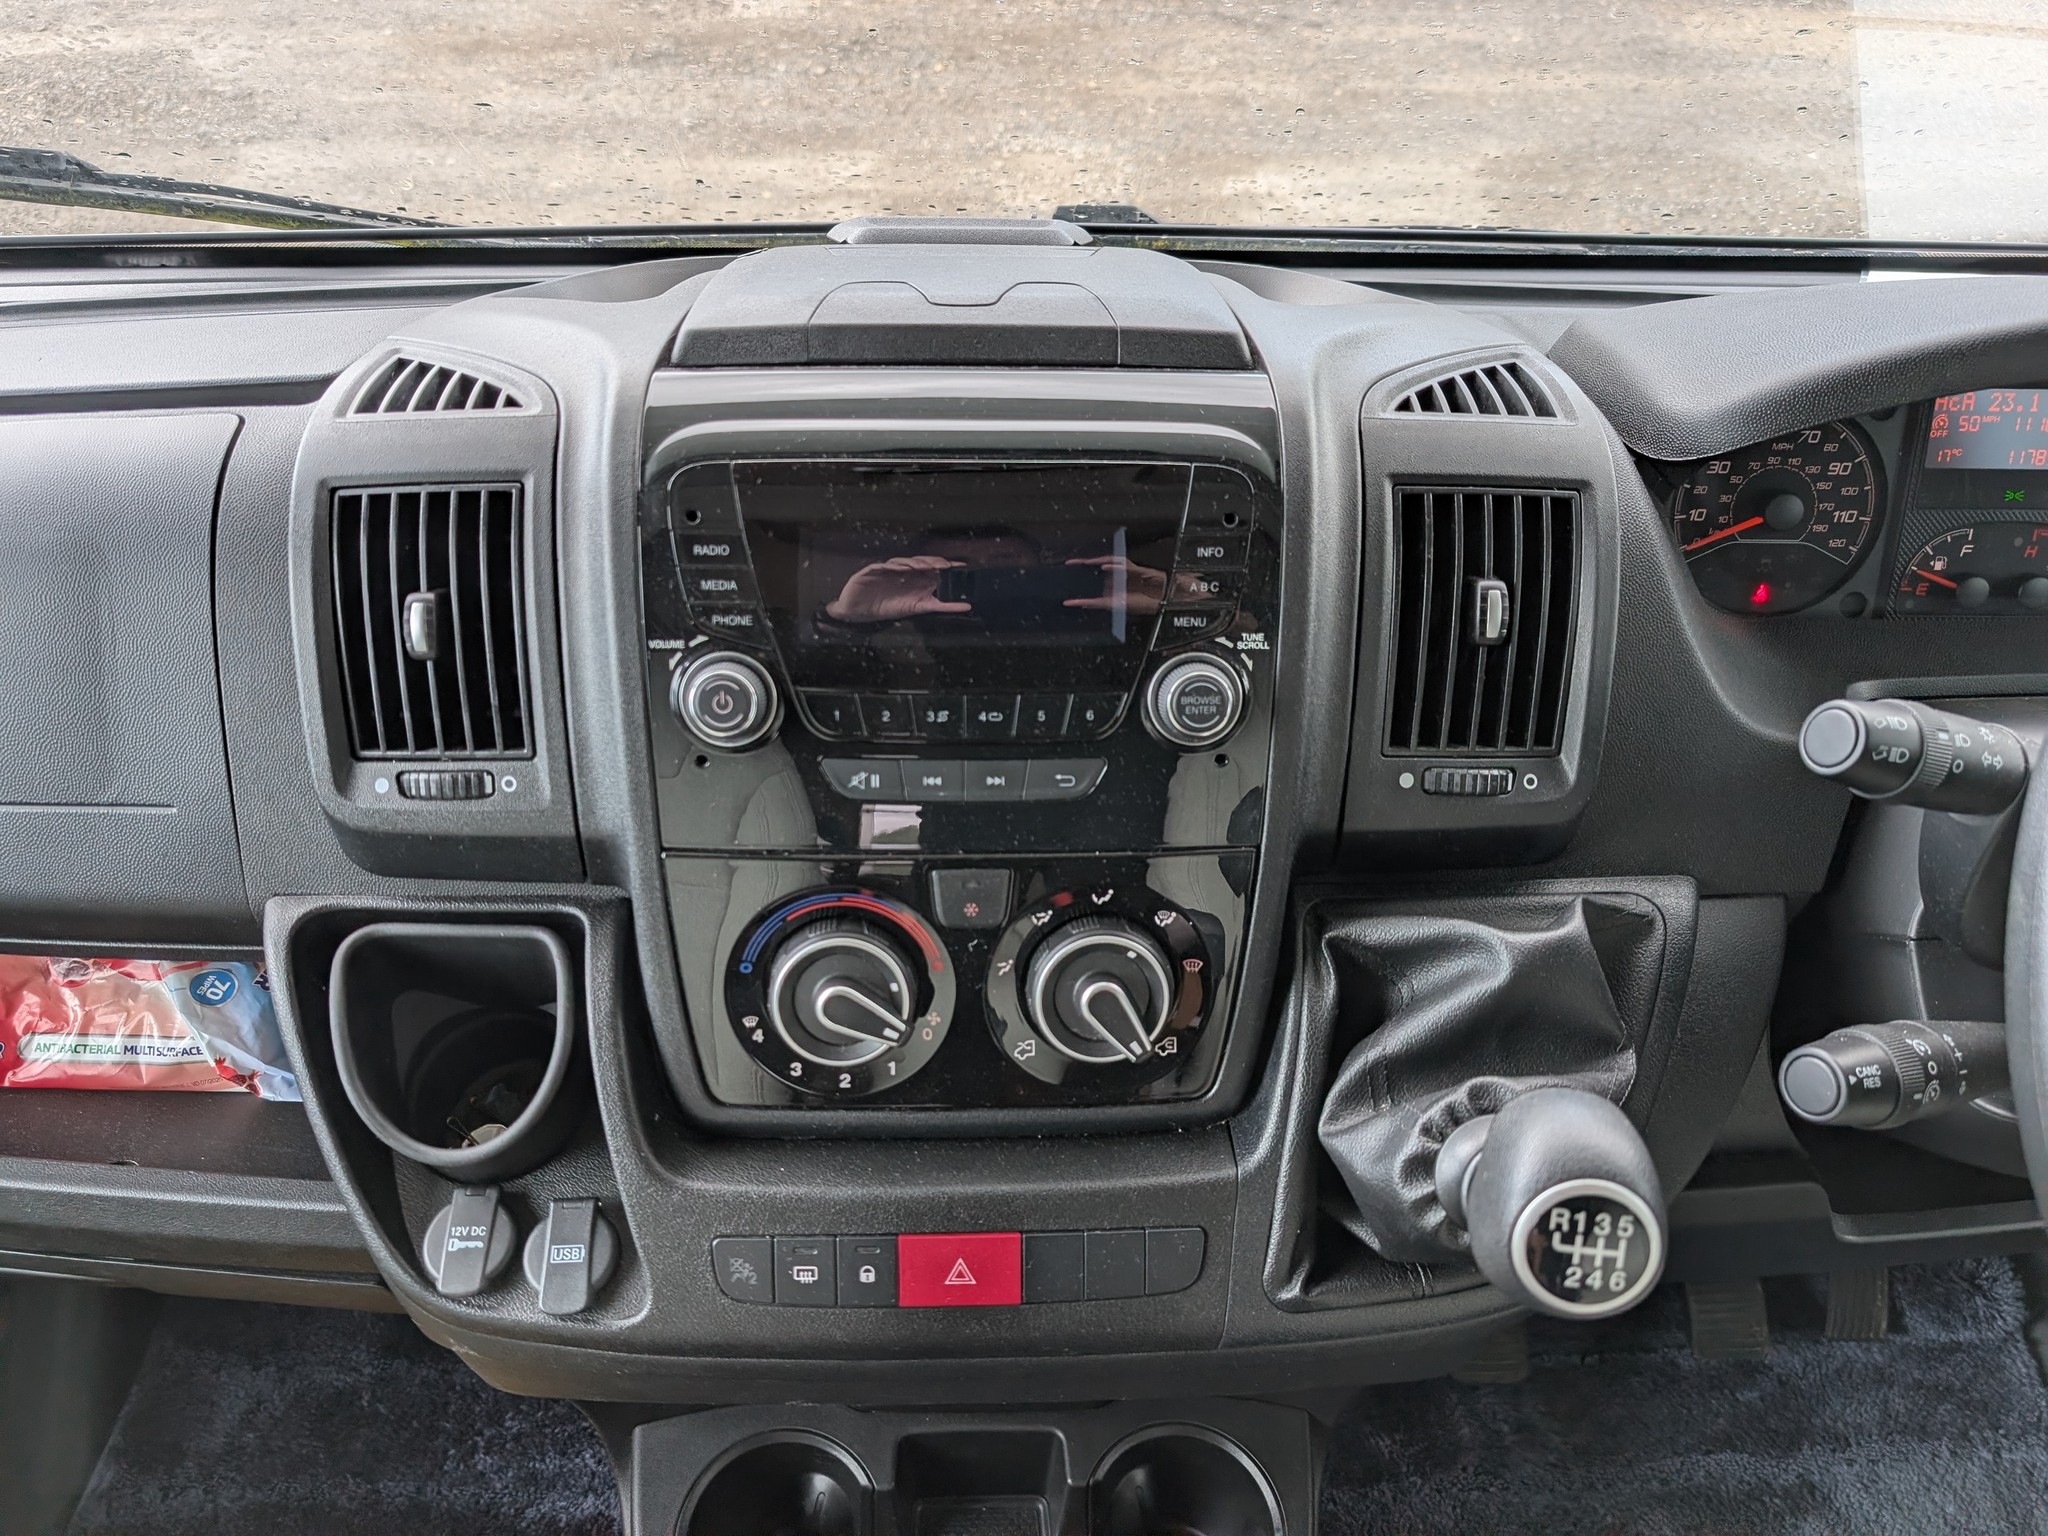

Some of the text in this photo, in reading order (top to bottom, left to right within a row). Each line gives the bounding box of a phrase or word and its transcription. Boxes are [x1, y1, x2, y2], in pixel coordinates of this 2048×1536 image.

[1958, 415, 1981, 432] 50
[1798, 431, 1821, 444] 70
[1930, 430, 1949, 438] OFF
[1772, 442, 1795, 451] MPH
[1823, 443, 1839, 452] 80
[1748, 462, 1761, 471] 70
[1767, 456, 1781, 465] 90
[1788, 457, 1802, 466] 110
[1706, 461, 1731, 474] 30
[1804, 466, 1822, 474] 130
[1827, 462, 1852, 475] 90
[1729, 475, 1743, 484] 50
[1693, 485, 1709, 495] 20
[1816, 482, 1833, 490] 150
[1840, 486, 1859, 496] 100
[1718, 495, 1733, 503] 30
[1819, 503, 1835, 511] 170
[1688, 508, 1707, 522] 10
[1718, 515, 1729, 524] 10
[1833, 510, 1858, 523] 110
[1812, 524, 1829, 533] 190
[1828, 538, 1847, 547] 120
[692, 544, 731, 557] RADIO
[1196, 546, 1224, 559] INFO
[1960, 544, 1975, 558] F
[2023, 545, 2039, 558] H
[701, 578, 738, 592] MEDIA
[1915, 582, 1931, 596] E
[711, 613, 753, 627] PHONE
[1173, 616, 1208, 628] MENU
[1241, 632, 1266, 642] TUNE
[648, 639, 686, 650] VOLUME
[1236, 641, 1271, 651] SCROLL
[1180, 695, 1222, 706] BROWSE
[833, 709, 841, 722] 1
[880, 709, 892, 723] 2
[1037, 710, 1047, 722] 5
[1086, 709, 1096, 721] 6
[1185, 705, 1217, 715] ENTER
[926, 710, 936, 723] 3
[978, 711, 987, 723] 4
[196, 974, 217, 996] WIPES
[205, 979, 232, 1001] 70
[751, 1028, 765, 1043] 4
[789, 1061, 803, 1077] 3
[887, 1060, 897, 1076] 1
[1855, 1063, 1882, 1078] CANC
[838, 1072, 853, 1089] 2
[1863, 1076, 1882, 1089] RES
[451, 1225, 487, 1237] 12V DC
[553, 1247, 581, 1262] USB
